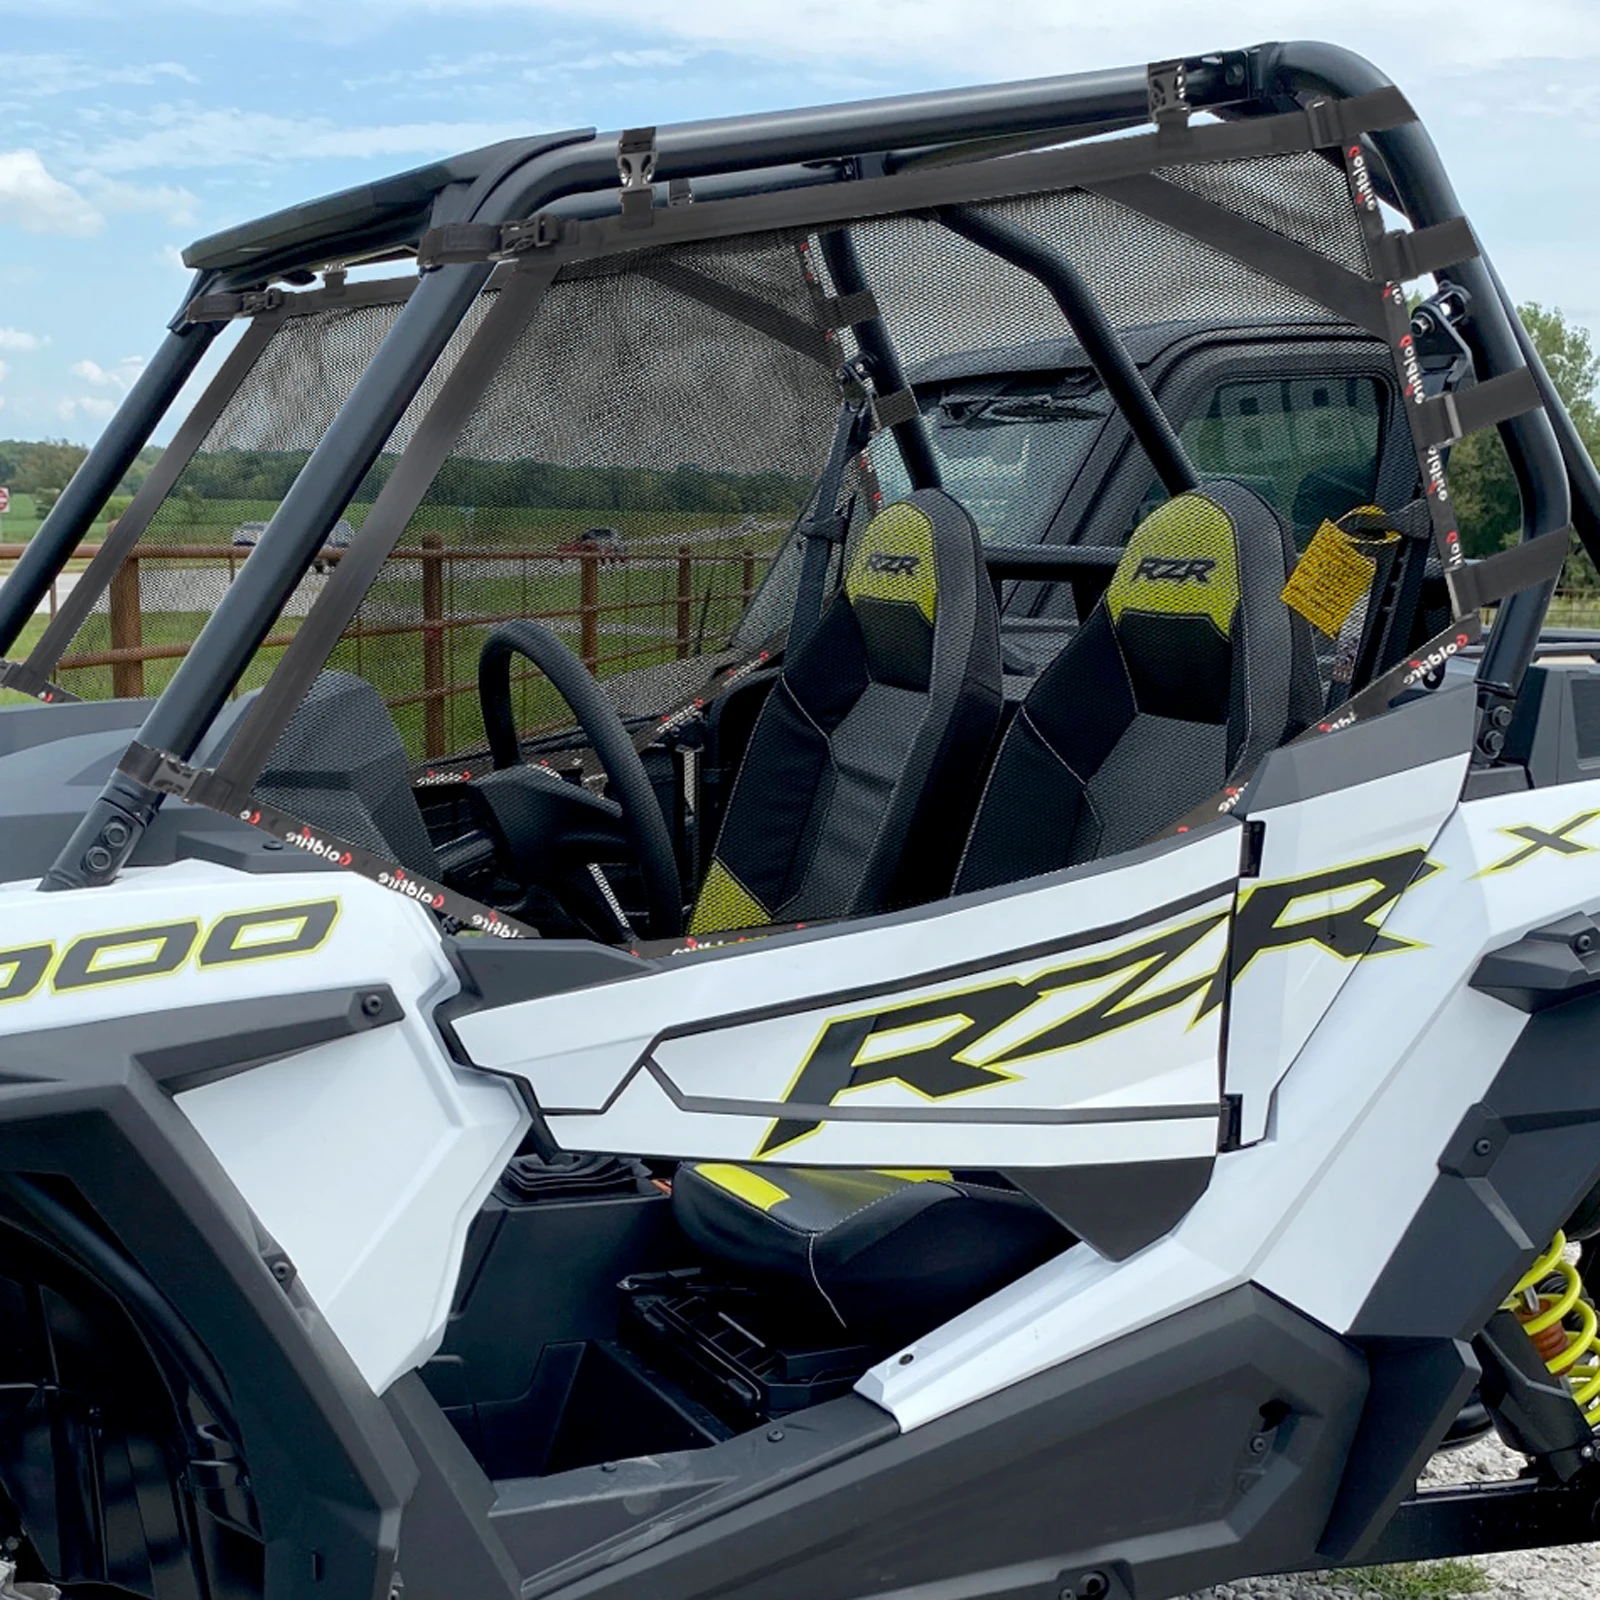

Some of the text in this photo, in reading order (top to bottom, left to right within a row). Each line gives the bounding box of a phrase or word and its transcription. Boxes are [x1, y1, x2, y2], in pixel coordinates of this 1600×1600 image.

[868, 552, 919, 576] RZR
[1131, 558, 1215, 583] RZR
[752, 844, 1447, 1159] RZR
